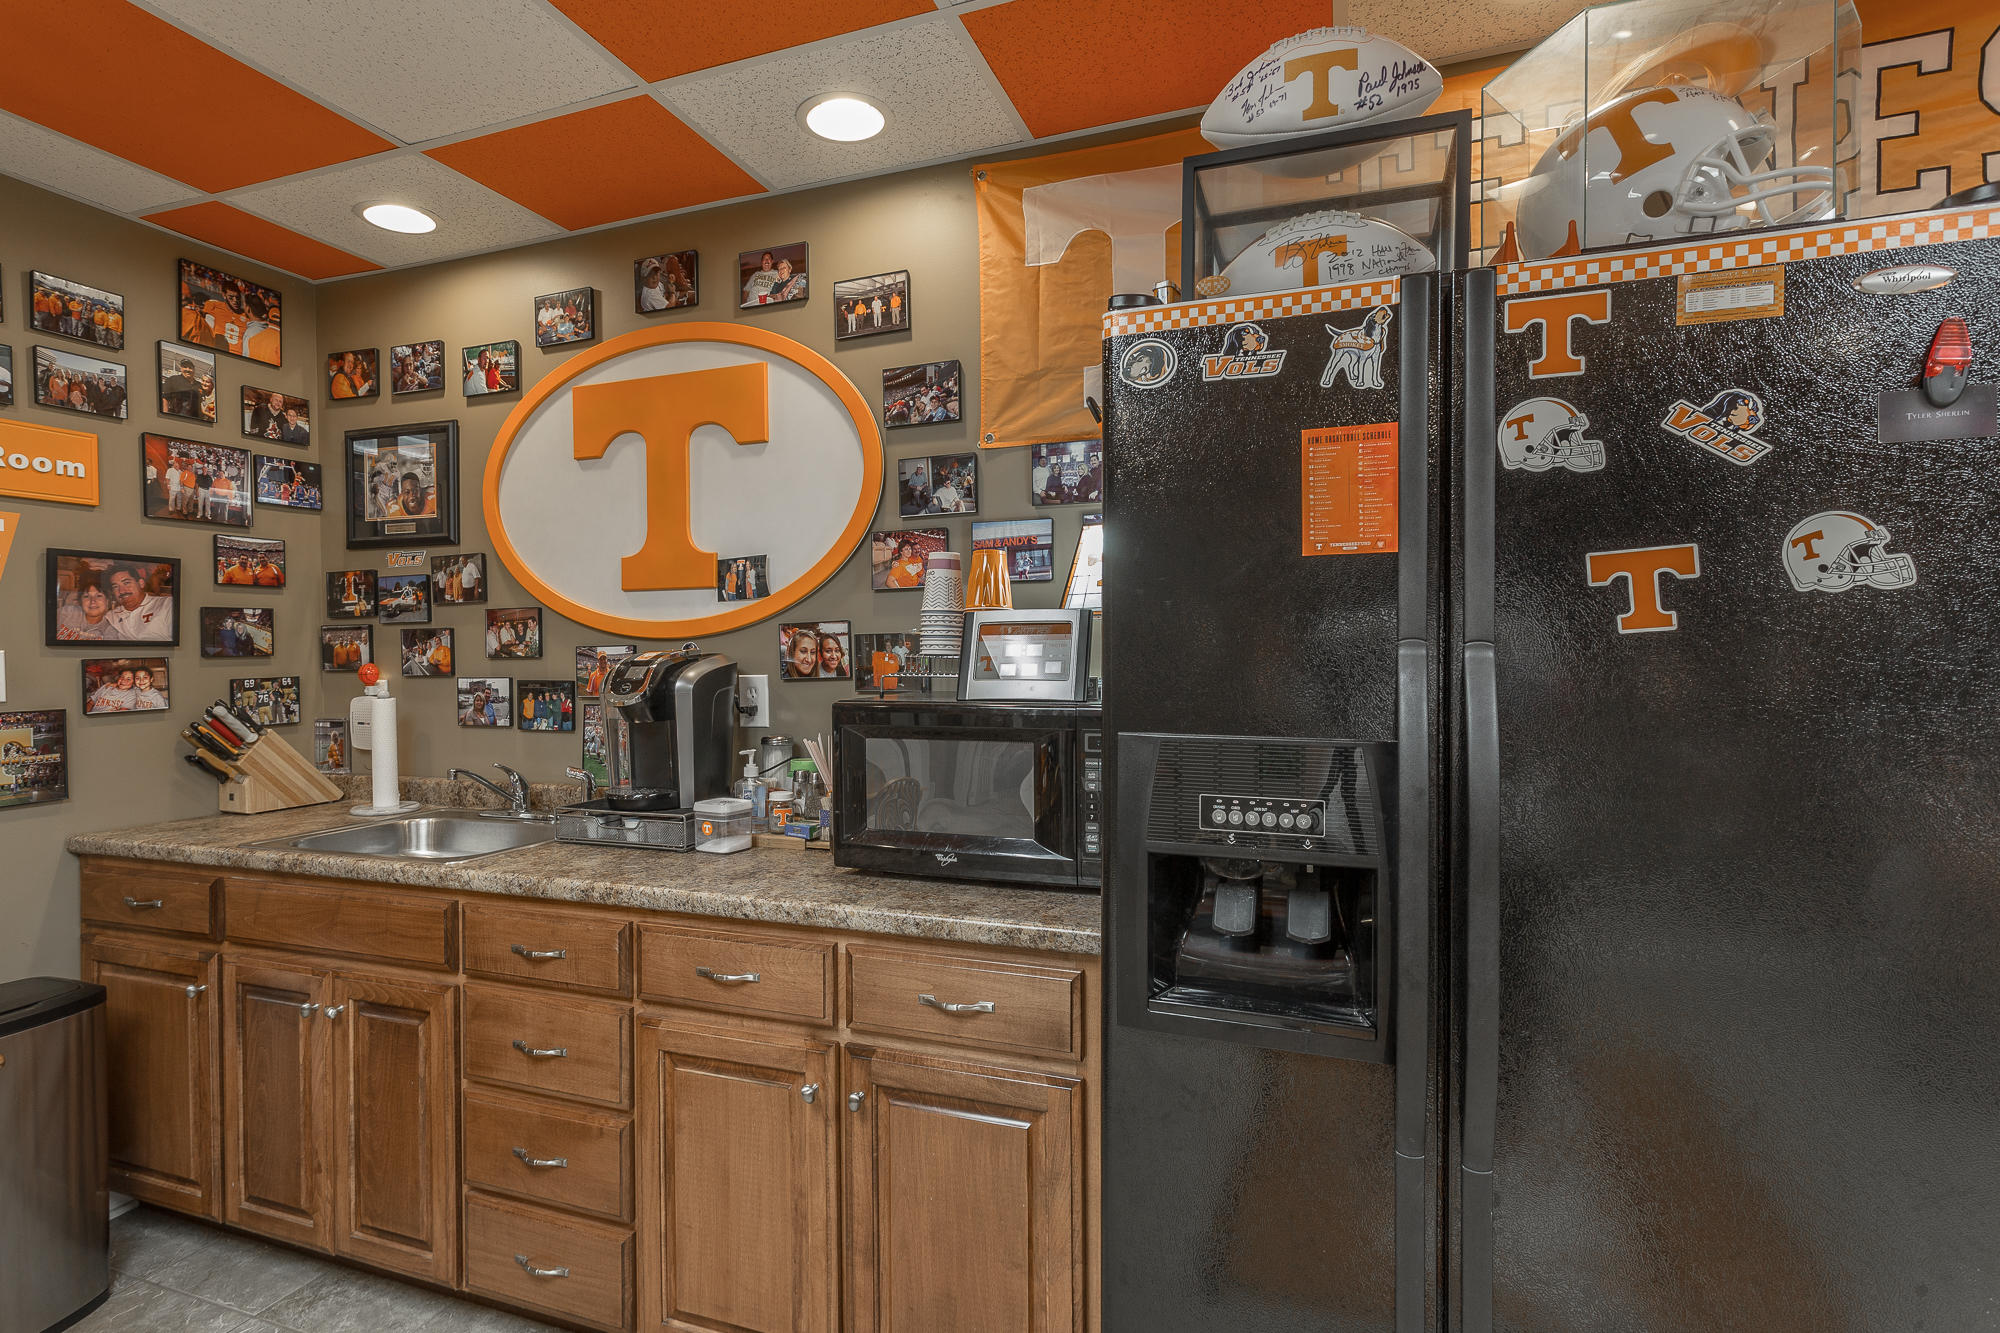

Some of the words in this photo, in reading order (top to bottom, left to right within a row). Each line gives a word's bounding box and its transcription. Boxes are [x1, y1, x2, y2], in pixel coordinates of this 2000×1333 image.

[1284, 48, 1358, 121] T
[1354, 94, 1383, 111] #52
[1396, 78, 1420, 97] 1975
[1328, 263, 1356, 280] 1998
[1883, 272, 1931, 284] Whirlpool
[1505, 290, 1611, 379] T
[1235, 354, 1282, 362] TENNESSEE
[1507, 414, 1534, 441] T
[572, 361, 770, 592] T
[974, 540, 994, 549] SAM
[1002, 535, 1039, 547] ANDY'S
[1791, 530, 1824, 560] T
[1586, 544, 1699, 633] T
[244, 680, 255, 688] 69
[282, 677, 291, 686] 64
[258, 694, 269, 703] 76
[774, 808, 793, 826] T
